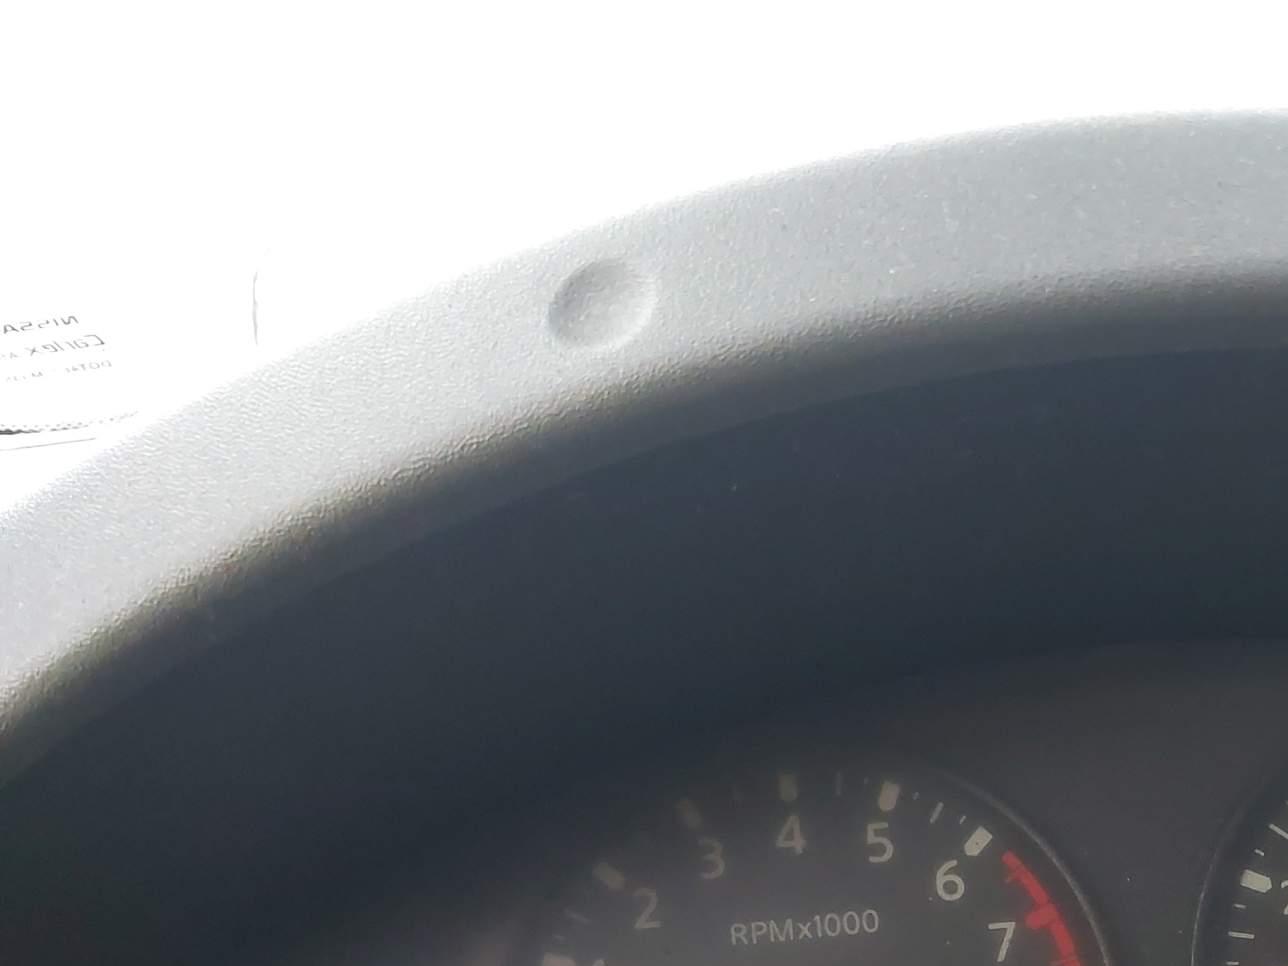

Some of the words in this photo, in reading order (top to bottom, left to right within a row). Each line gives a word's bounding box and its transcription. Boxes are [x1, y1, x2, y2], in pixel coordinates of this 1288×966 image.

[775, 815, 806, 853] 4
[866, 822, 894, 863] 5
[700, 840, 725, 879] 3
[935, 860, 965, 901] 6
[634, 890, 661, 929] 2
[731, 909, 880, 946] RPMx1000
[988, 921, 1016, 962] 7
